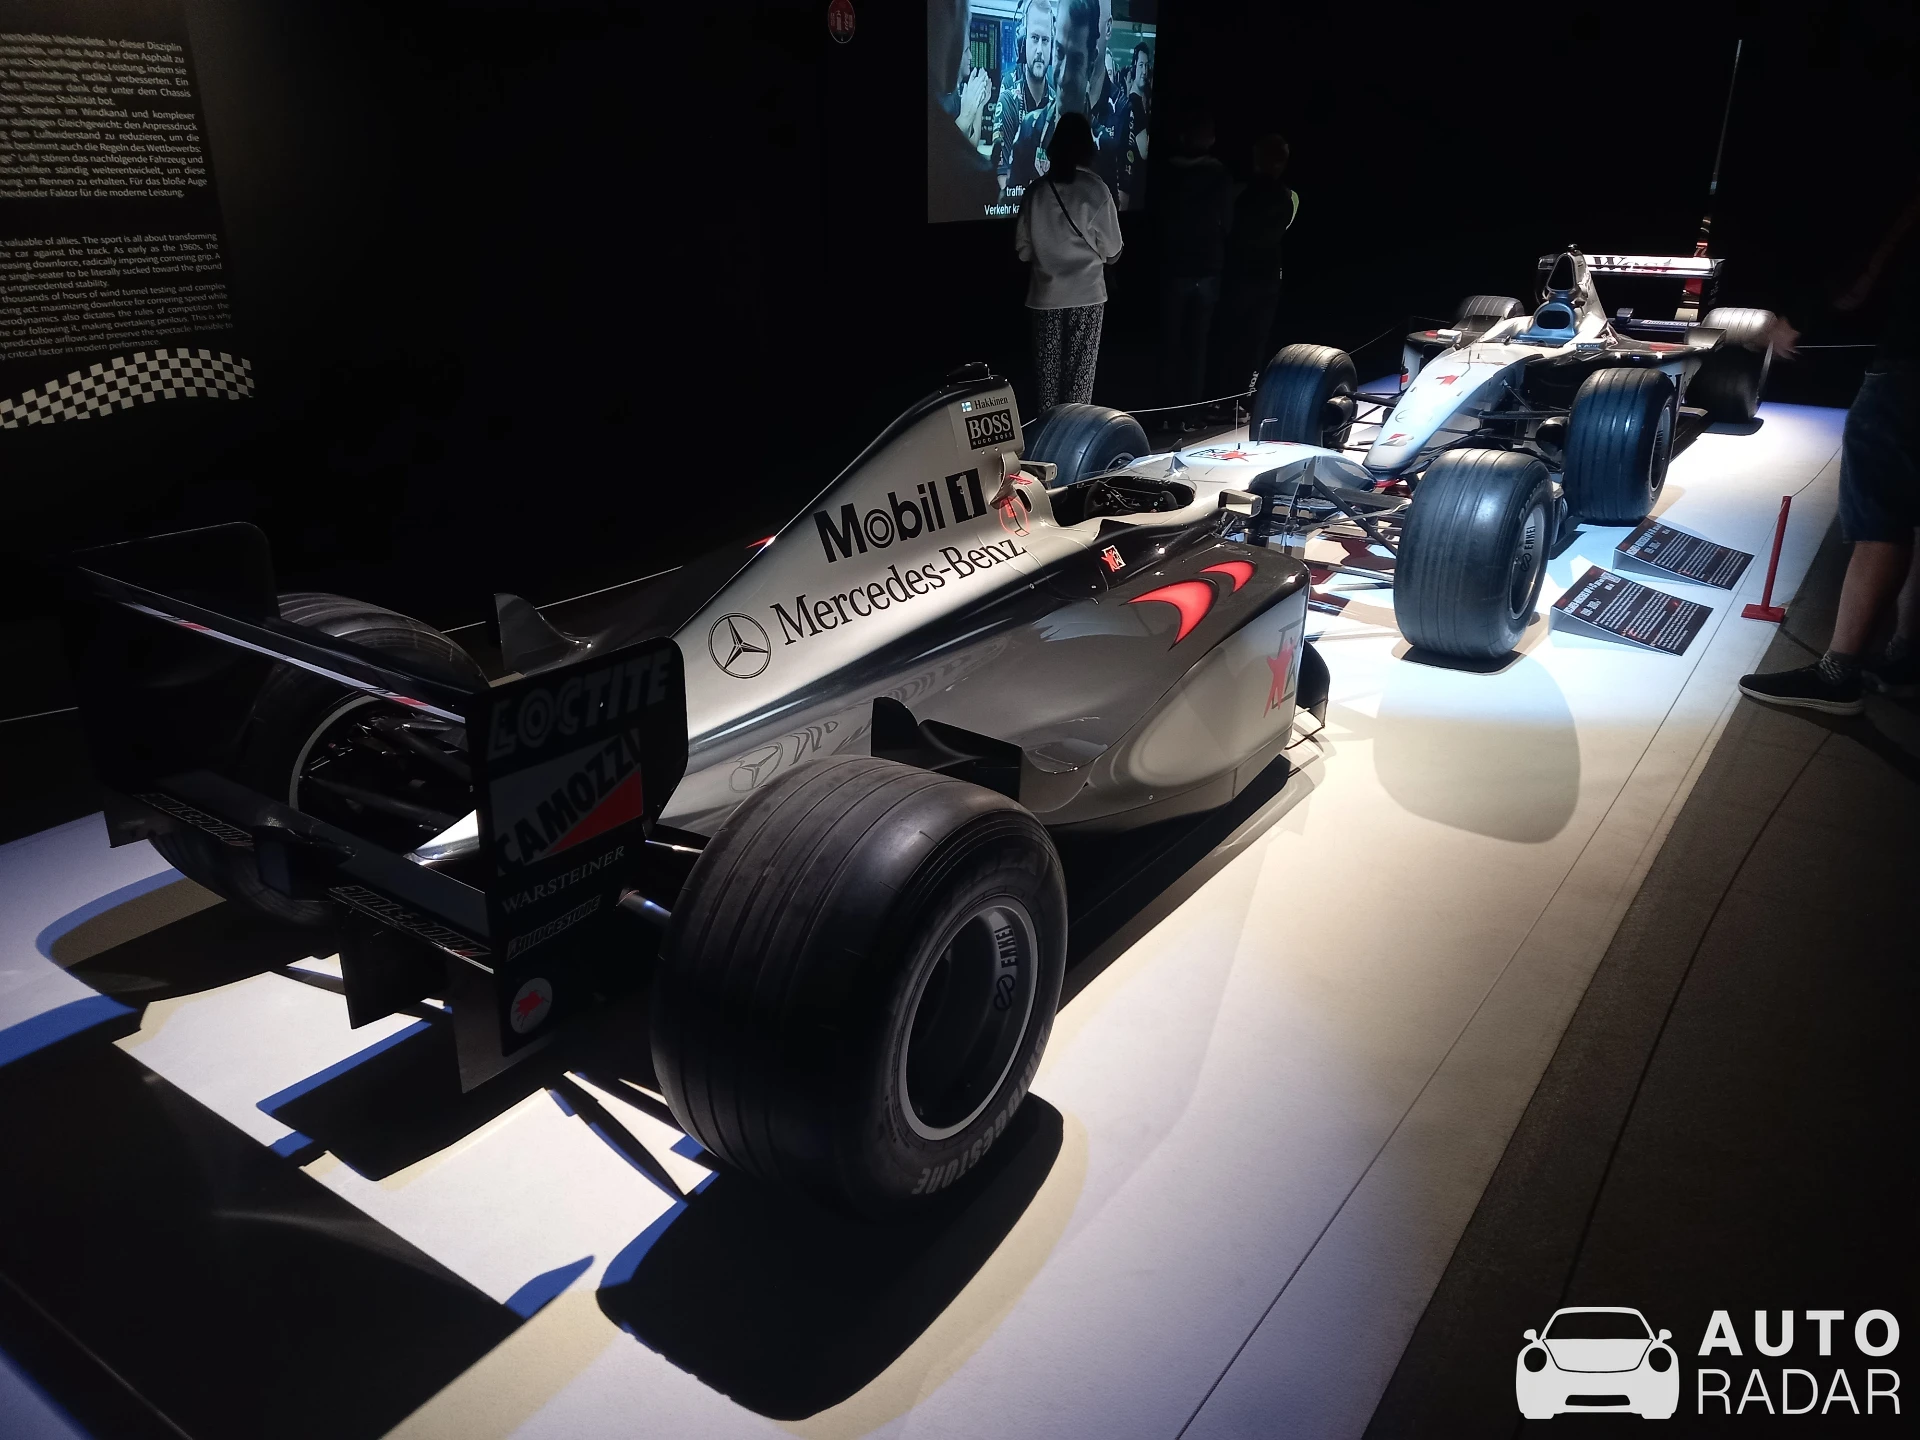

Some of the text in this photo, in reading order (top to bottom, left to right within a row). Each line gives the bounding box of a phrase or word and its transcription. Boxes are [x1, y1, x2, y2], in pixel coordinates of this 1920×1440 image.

[119, 39, 145, 49] dieser
[147, 41, 182, 53] Disziplin
[106, 51, 121, 60] auf
[122, 52, 140, 61] den
[141, 53, 173, 63] Asphalt
[147, 65, 174, 74] indem
[175, 66, 187, 75] sie
[116, 75, 189, 87] verbesserten. Ein
[92, 85, 107, 94] der
[111, 87, 134, 95] unter
[138, 87, 157, 96] dem
[160, 88, 191, 98] Chassis
[98, 97, 115, 105] bot.
[81, 108, 128, 117] Windkanal
[132, 110, 148, 118] und
[152, 110, 195, 121] komplexer
[124, 121, 141, 129] den
[142, 121, 198, 131] Anpressdruck
[119, 132, 166, 142] reduzieren,
[169, 134, 183, 142] um
[187, 133, 199, 142] die
[61, 143, 202, 153] auch die Regeln des Wettbewerbs:
[41, 154, 203, 165] stören das nachfolgende Fahrzeug und
[55, 166, 90, 176] ständig
[184, 167, 206, 175] diese
[39, 177, 74, 185] Rennen
[89, 177, 127, 185] erhalten.
[129, 177, 143, 185] Für
[145, 177, 161, 185] das
[162, 177, 186, 185] bloße
[188, 177, 208, 187] Auge
[50, 188, 148, 197] Faktor für die moderne
[984, 204, 1011, 215] Verkehr
[4, 232, 217, 247] valuable of allies. The sport is all about transforming
[33, 248, 66, 259] against
[68, 247, 84, 256] the
[113, 246, 125, 254] As
[127, 245, 147, 255] early
[162, 244, 176, 252] the
[206, 242, 219, 251] the
[33, 252, 221, 269] downforce, radically improving cornering grip. A
[8, 262, 222, 282] single-seater to be literally sucked toward the ground
[2, 282, 226, 304] thousands of hours of wind tunnel testing and complex
[7, 279, 110, 294] unprecedented stability.
[40, 302, 90, 313] maximizing
[90, 299, 133, 309] downforce
[135, 298, 145, 306] for
[147, 295, 184, 305] cornering
[184, 293, 207, 304] speed
[208, 292, 228, 301] while
[62, 302, 229, 322] also dictates the rules of the
[13, 329, 26, 337] car
[29, 325, 70, 335] following
[82, 321, 113, 331] making
[114, 317, 156, 328] overtaking
[191, 313, 207, 322] This
[208, 312, 215, 321] is
[216, 311, 232, 321] why
[55, 334, 87, 344] airflows
[88, 332, 105, 341] and
[106, 330, 141, 342] preserve
[142, 328, 155, 337] the
[7, 339, 161, 359] critical factor in modern performance.
[968, 413, 1011, 439] BOSS
[814, 481, 945, 563] Mobil
[770, 538, 1027, 645] Mercedes-Benz
[487, 648, 672, 761] LOCTITE
[501, 845, 626, 916] WARSTEINER
[994, 924, 1019, 968] ENKEI
